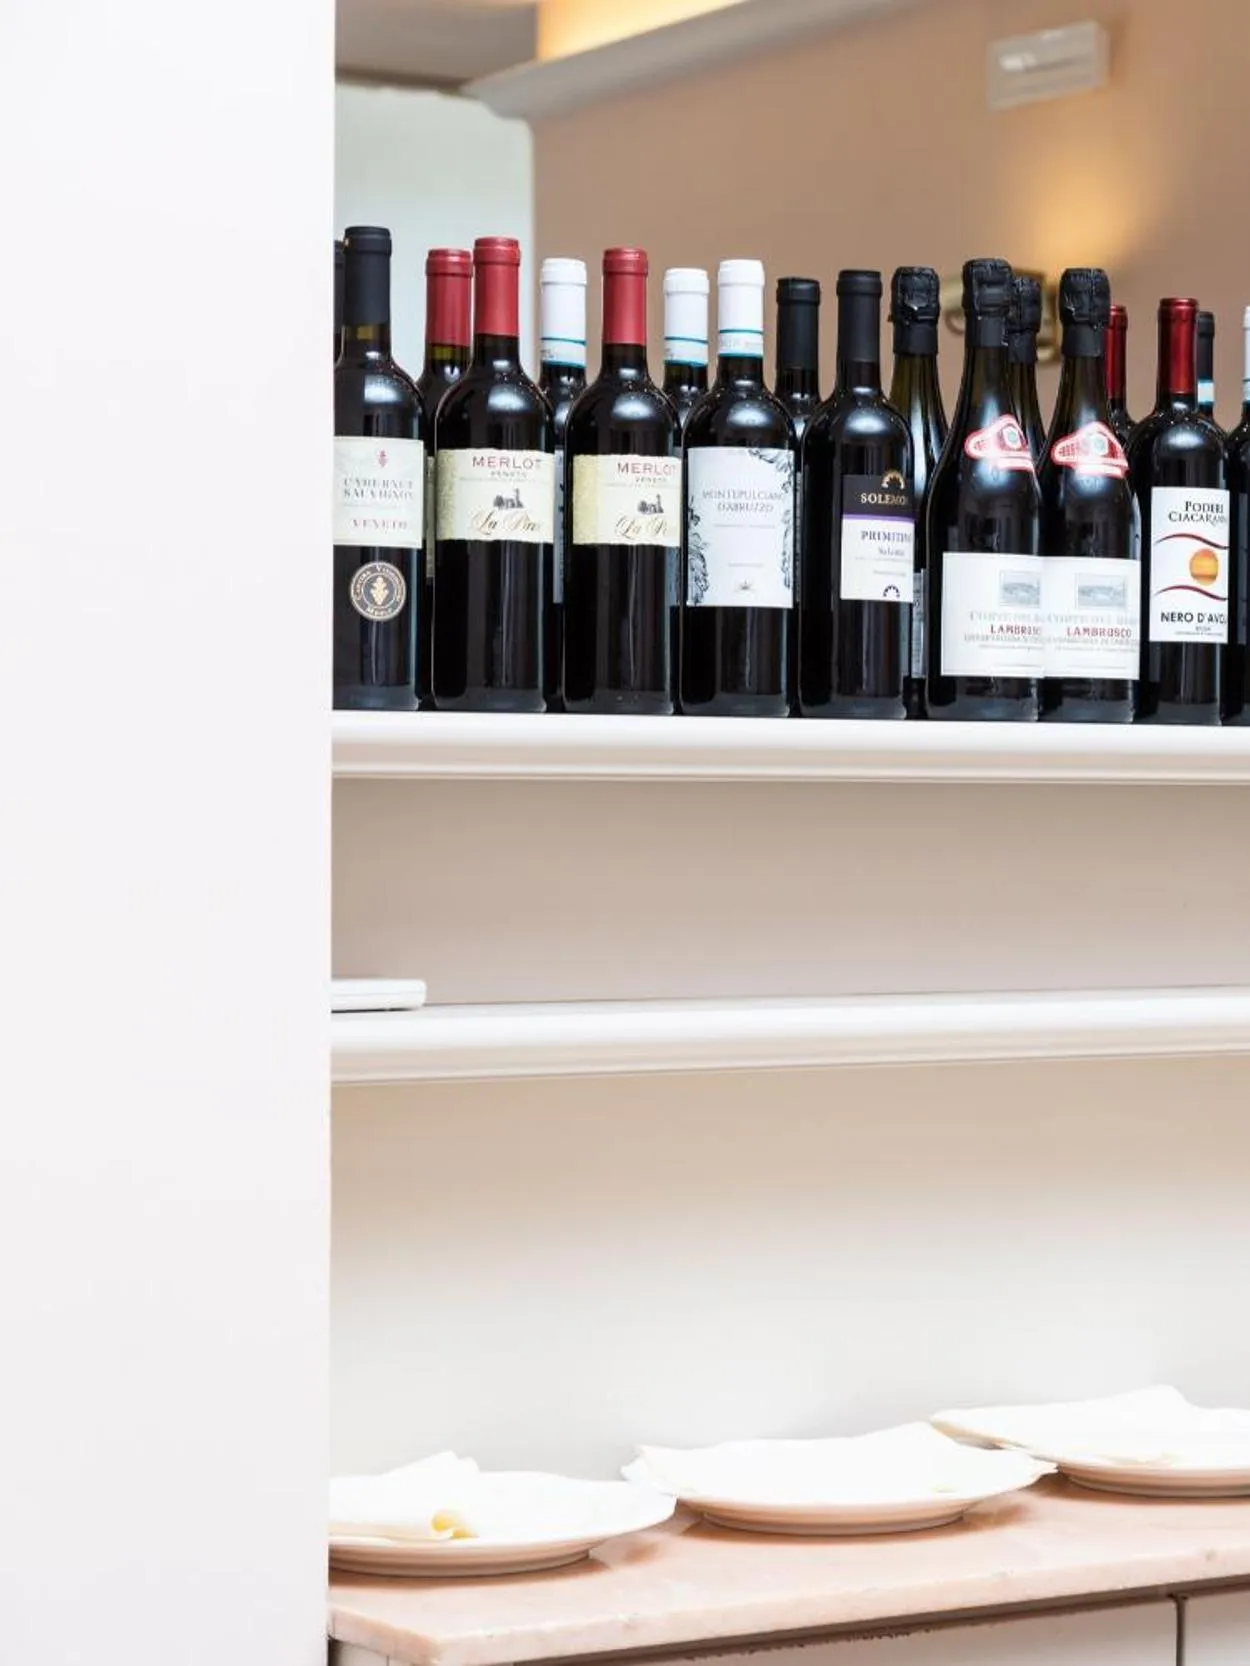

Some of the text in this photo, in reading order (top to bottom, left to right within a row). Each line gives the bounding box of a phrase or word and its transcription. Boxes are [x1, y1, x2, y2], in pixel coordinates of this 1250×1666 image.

[472, 456, 543, 470] MERLOT
[344, 477, 414, 489] CABERNET
[352, 519, 408, 530] VENETO
[1160, 611, 1194, 623] NERO
